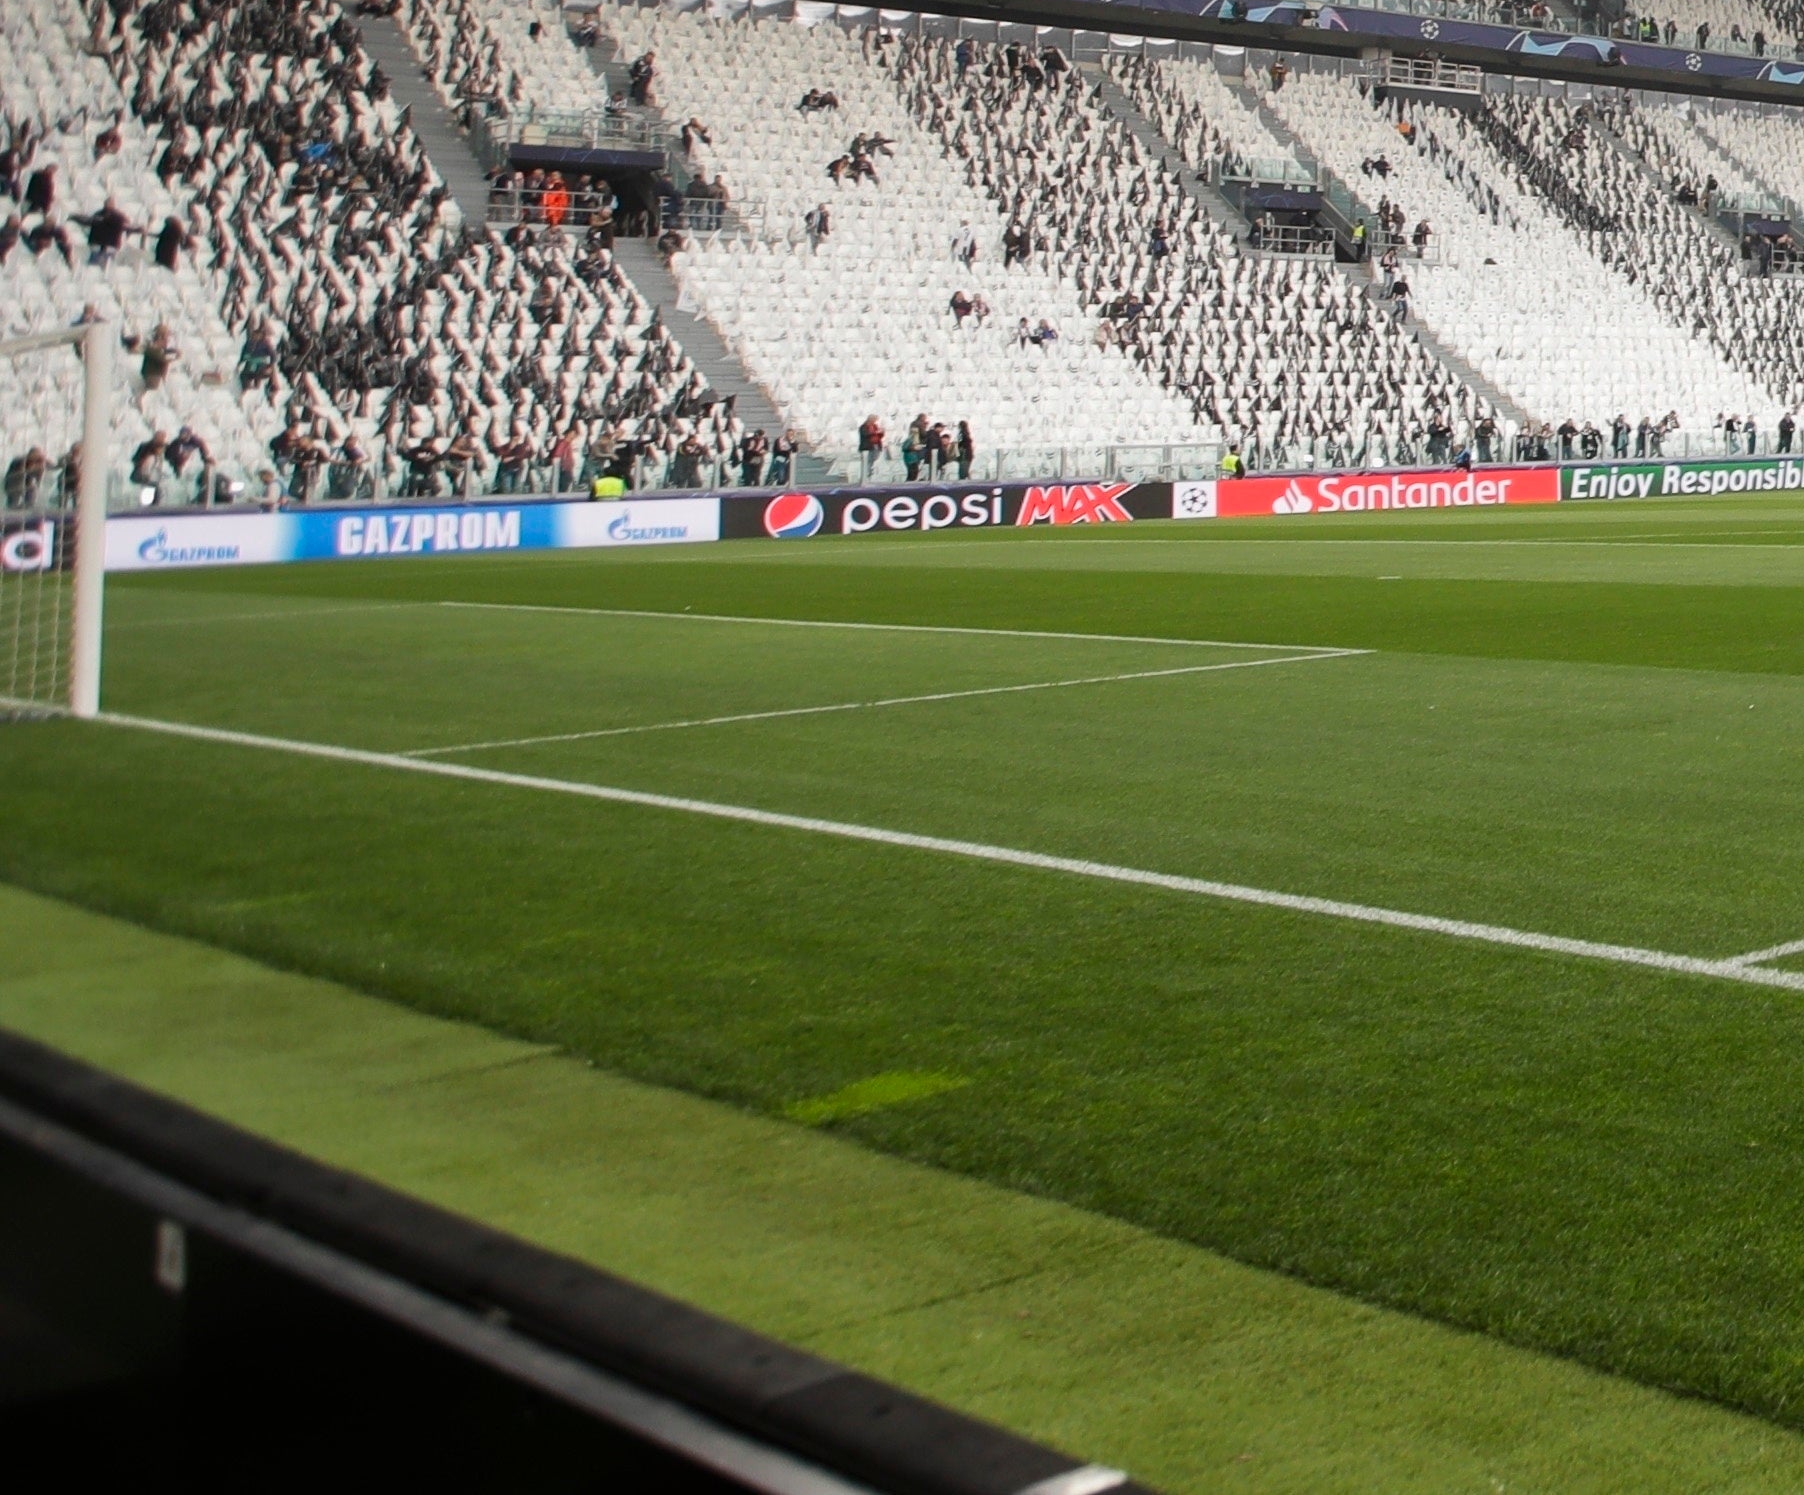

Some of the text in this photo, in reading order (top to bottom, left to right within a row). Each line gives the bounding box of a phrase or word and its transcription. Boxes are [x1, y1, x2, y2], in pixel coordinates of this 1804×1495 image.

[1316, 469, 1511, 512] Santander
[1570, 465, 1654, 501] Enjoy
[842, 483, 1137, 535] pepsi MAX
[167, 545, 239, 562] GAZPROM
[338, 510, 520, 555] GAZPROM
